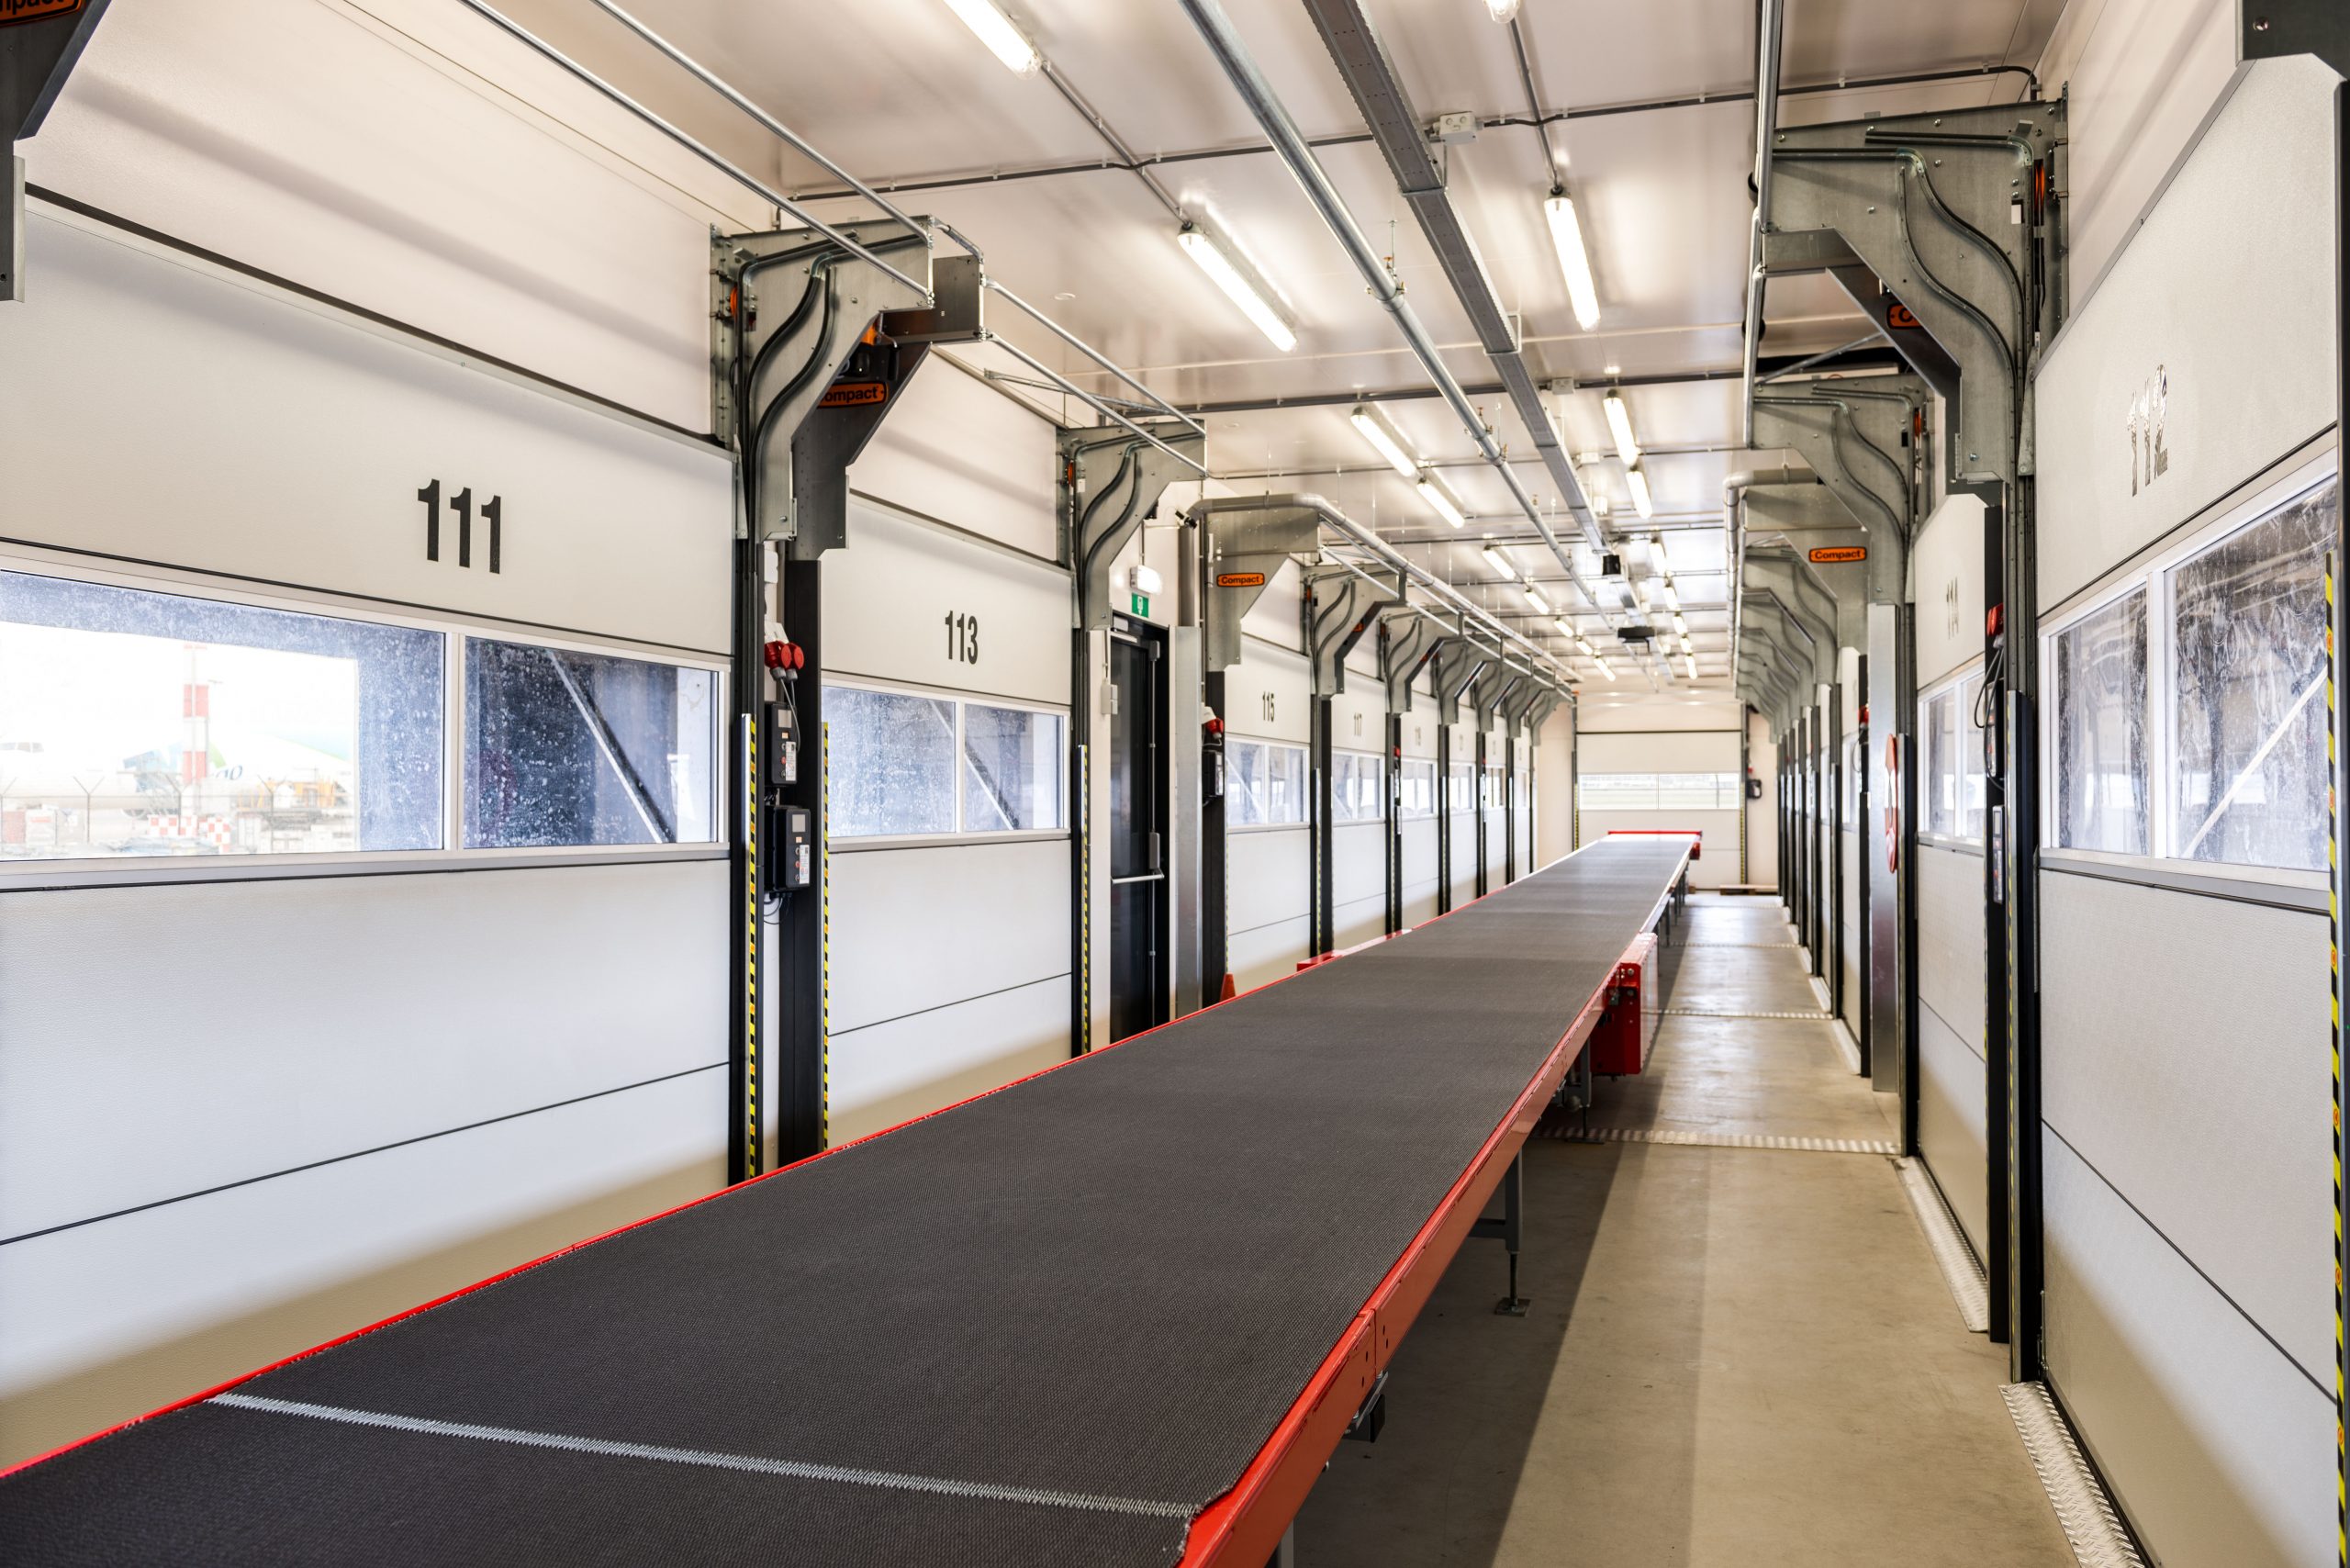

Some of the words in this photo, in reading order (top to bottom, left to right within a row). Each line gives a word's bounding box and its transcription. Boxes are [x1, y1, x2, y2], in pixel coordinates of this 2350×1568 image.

[822, 386, 878, 403] ompact
[418, 478, 501, 574] 111
[1815, 550, 1861, 561] Compact
[1221, 576, 1259, 585] Compact
[945, 610, 979, 665] 113
[1262, 690, 1275, 722] 115
